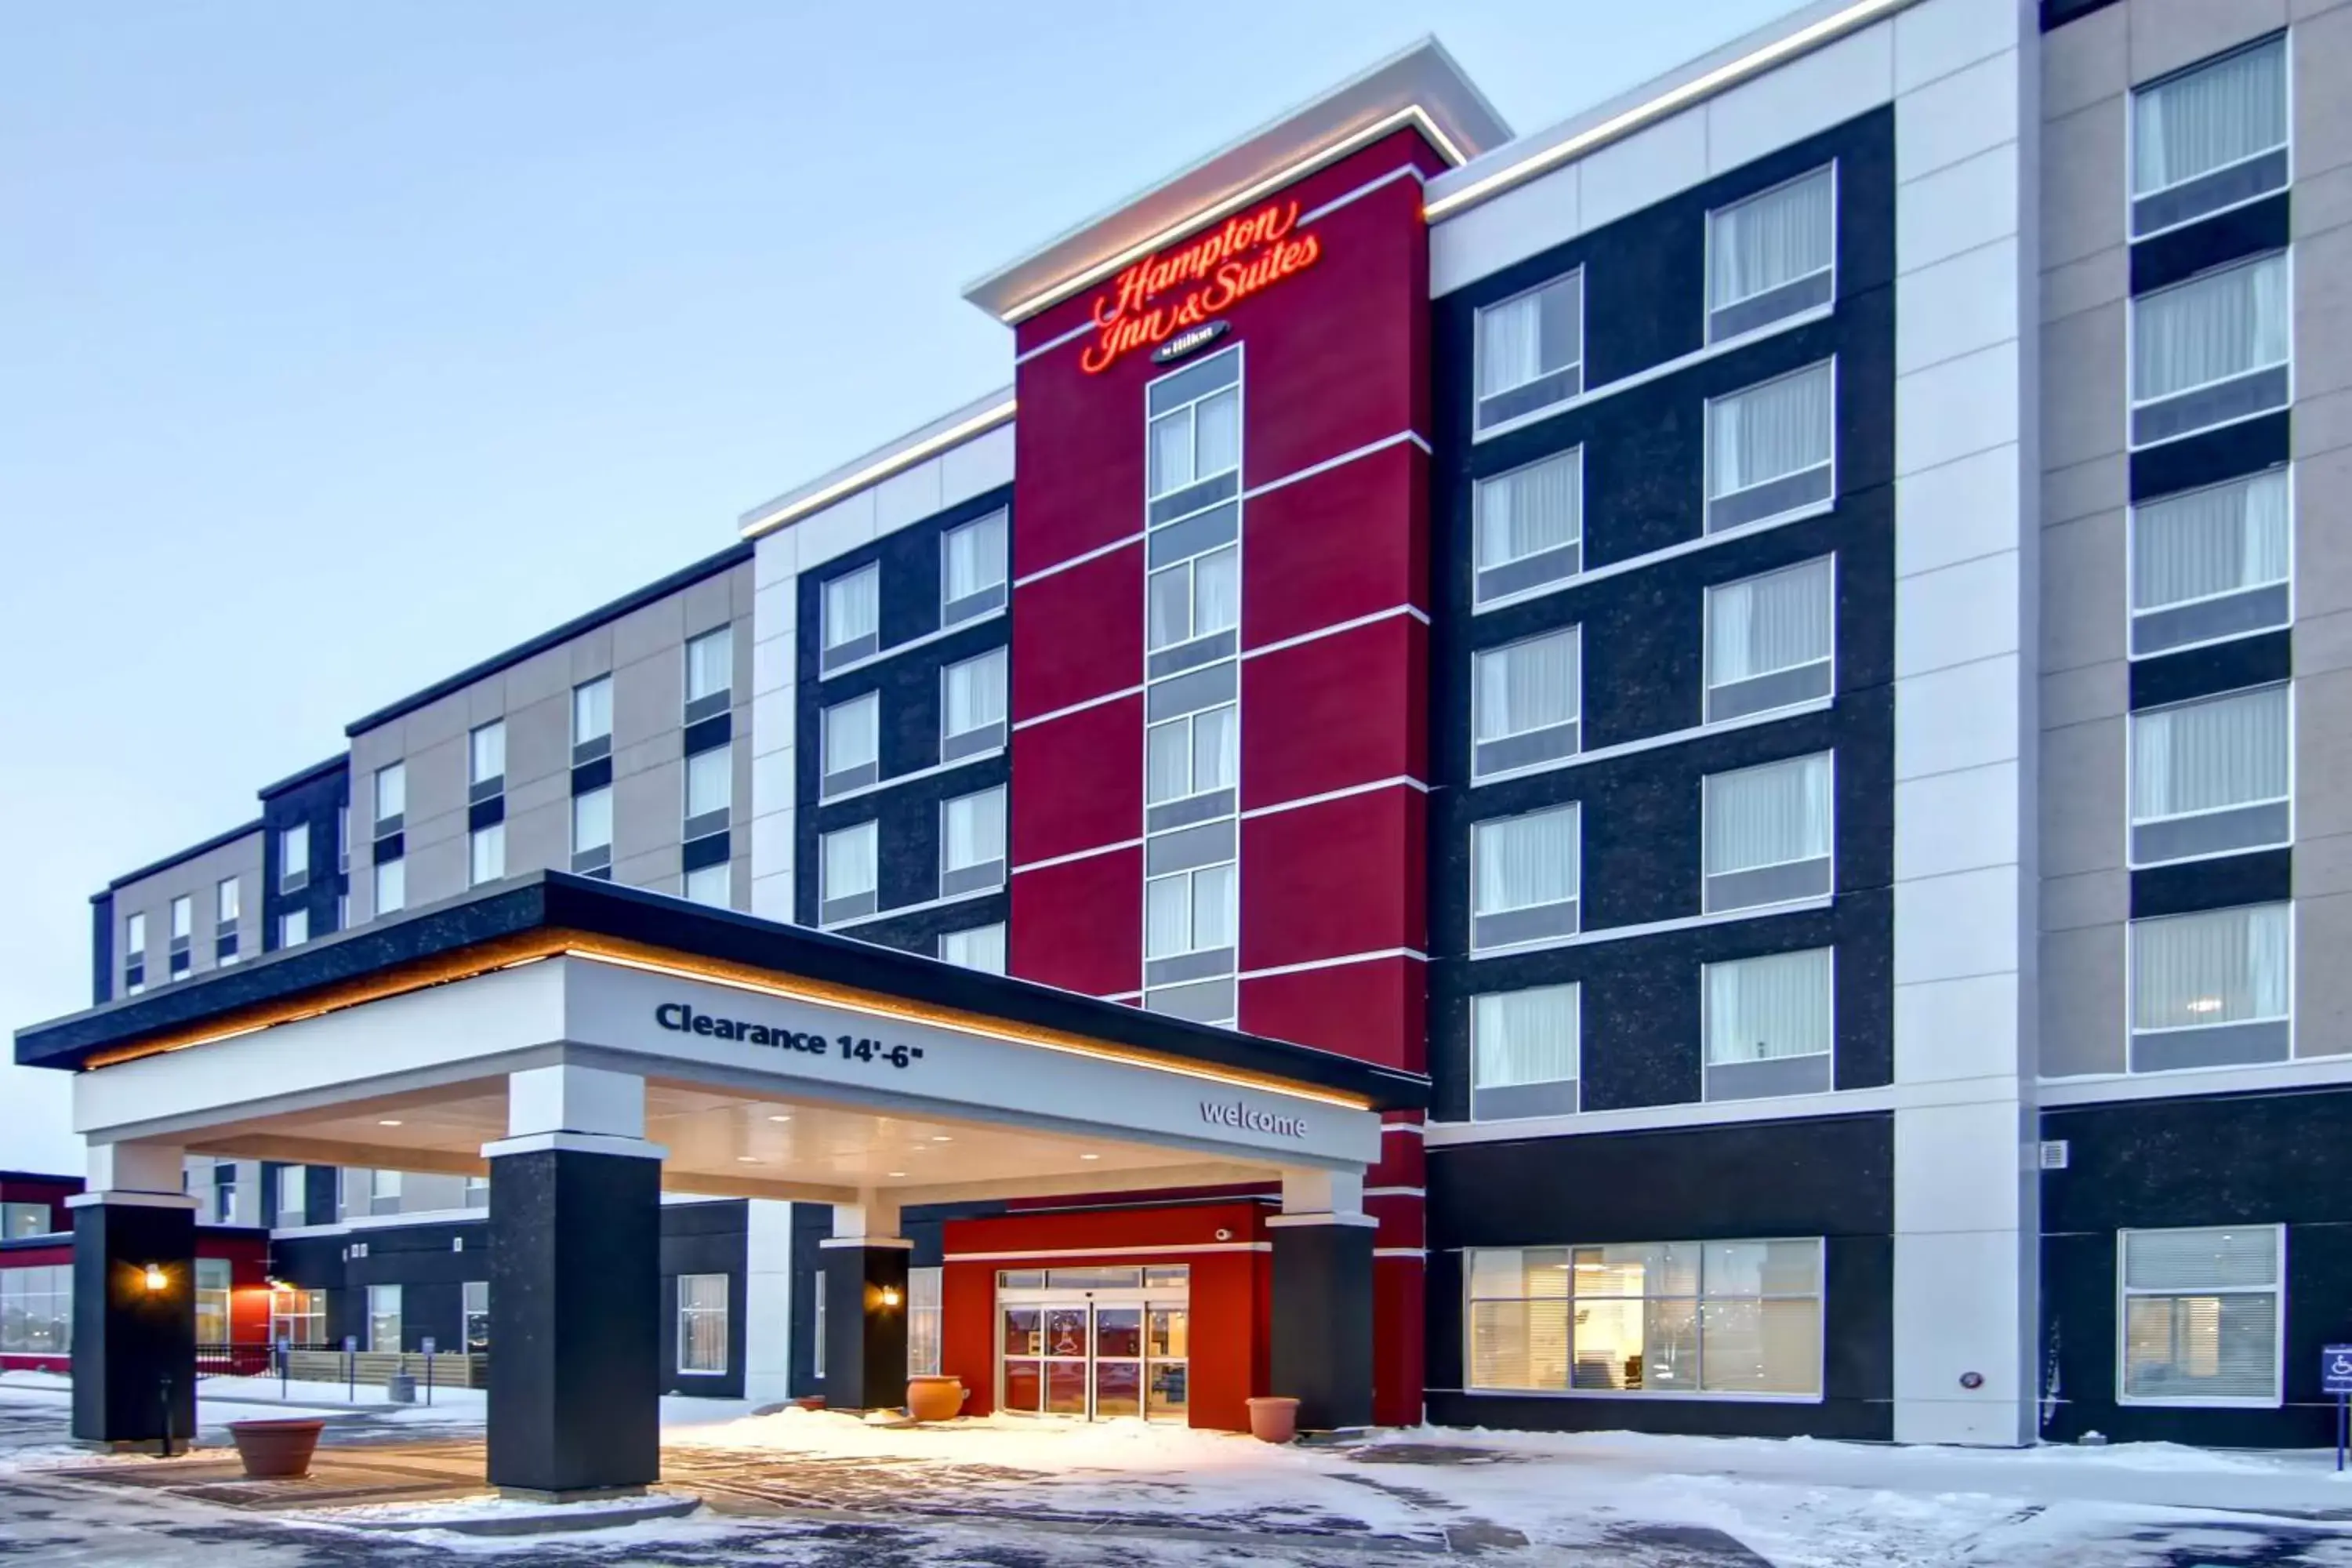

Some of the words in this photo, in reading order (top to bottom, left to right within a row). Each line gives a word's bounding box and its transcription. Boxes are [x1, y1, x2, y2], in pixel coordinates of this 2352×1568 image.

[1081, 305, 1178, 373] Inn
[1179, 292, 1205, 325] &
[1202, 234, 1319, 311] Suites
[1094, 201, 1298, 327] Hampton
[655, 1003, 827, 1054] Clearance
[836, 1035, 924, 1069] 14'-6"
[1200, 1102, 1308, 1139] welcome
